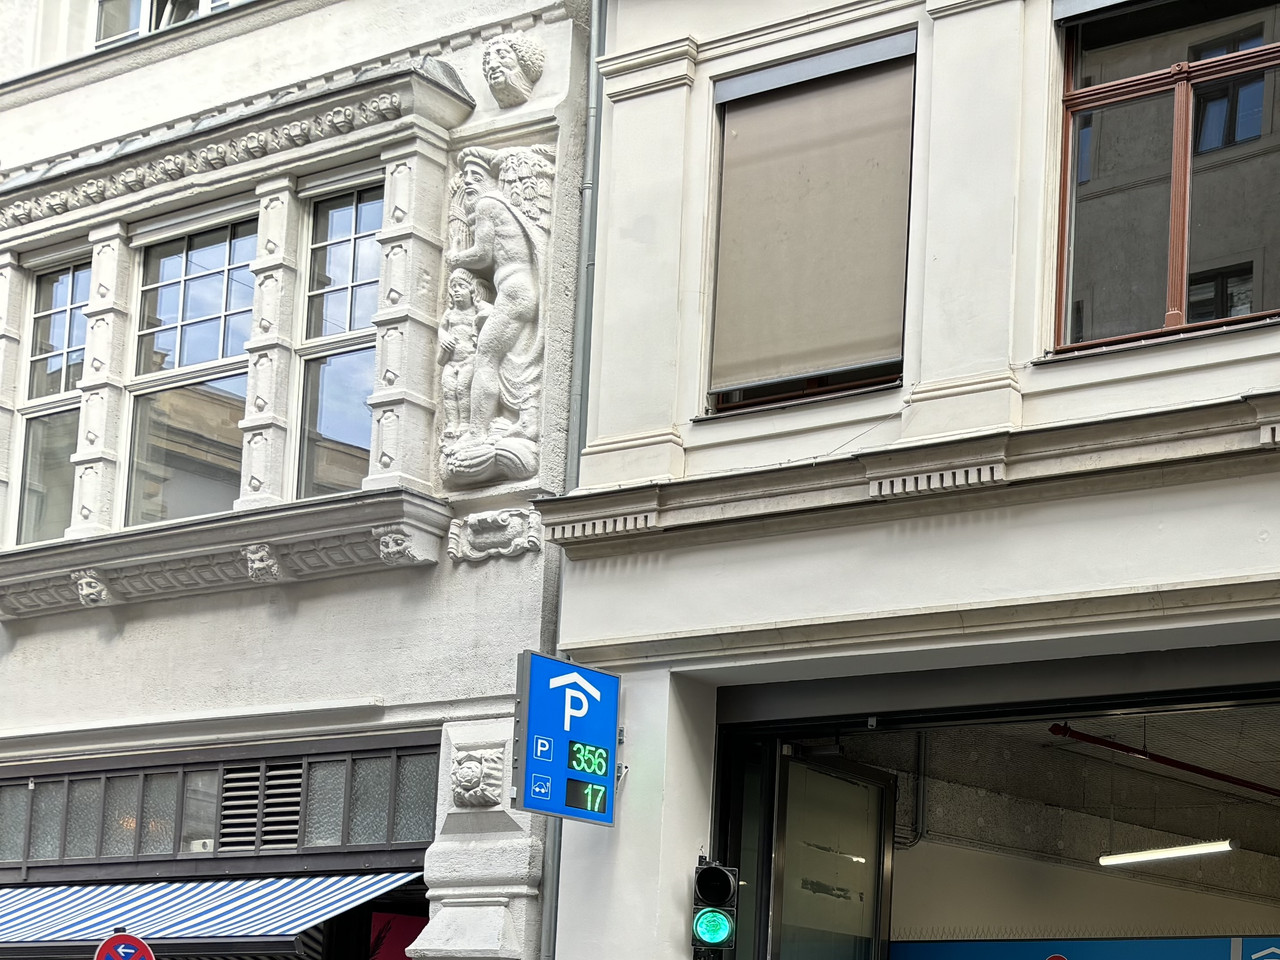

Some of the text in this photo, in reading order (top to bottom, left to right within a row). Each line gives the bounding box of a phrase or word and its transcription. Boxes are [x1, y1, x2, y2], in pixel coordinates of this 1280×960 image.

[564, 687, 589, 732] P
[537, 739, 549, 757] P
[572, 743, 607, 776] 356
[584, 783, 605, 812] 17
